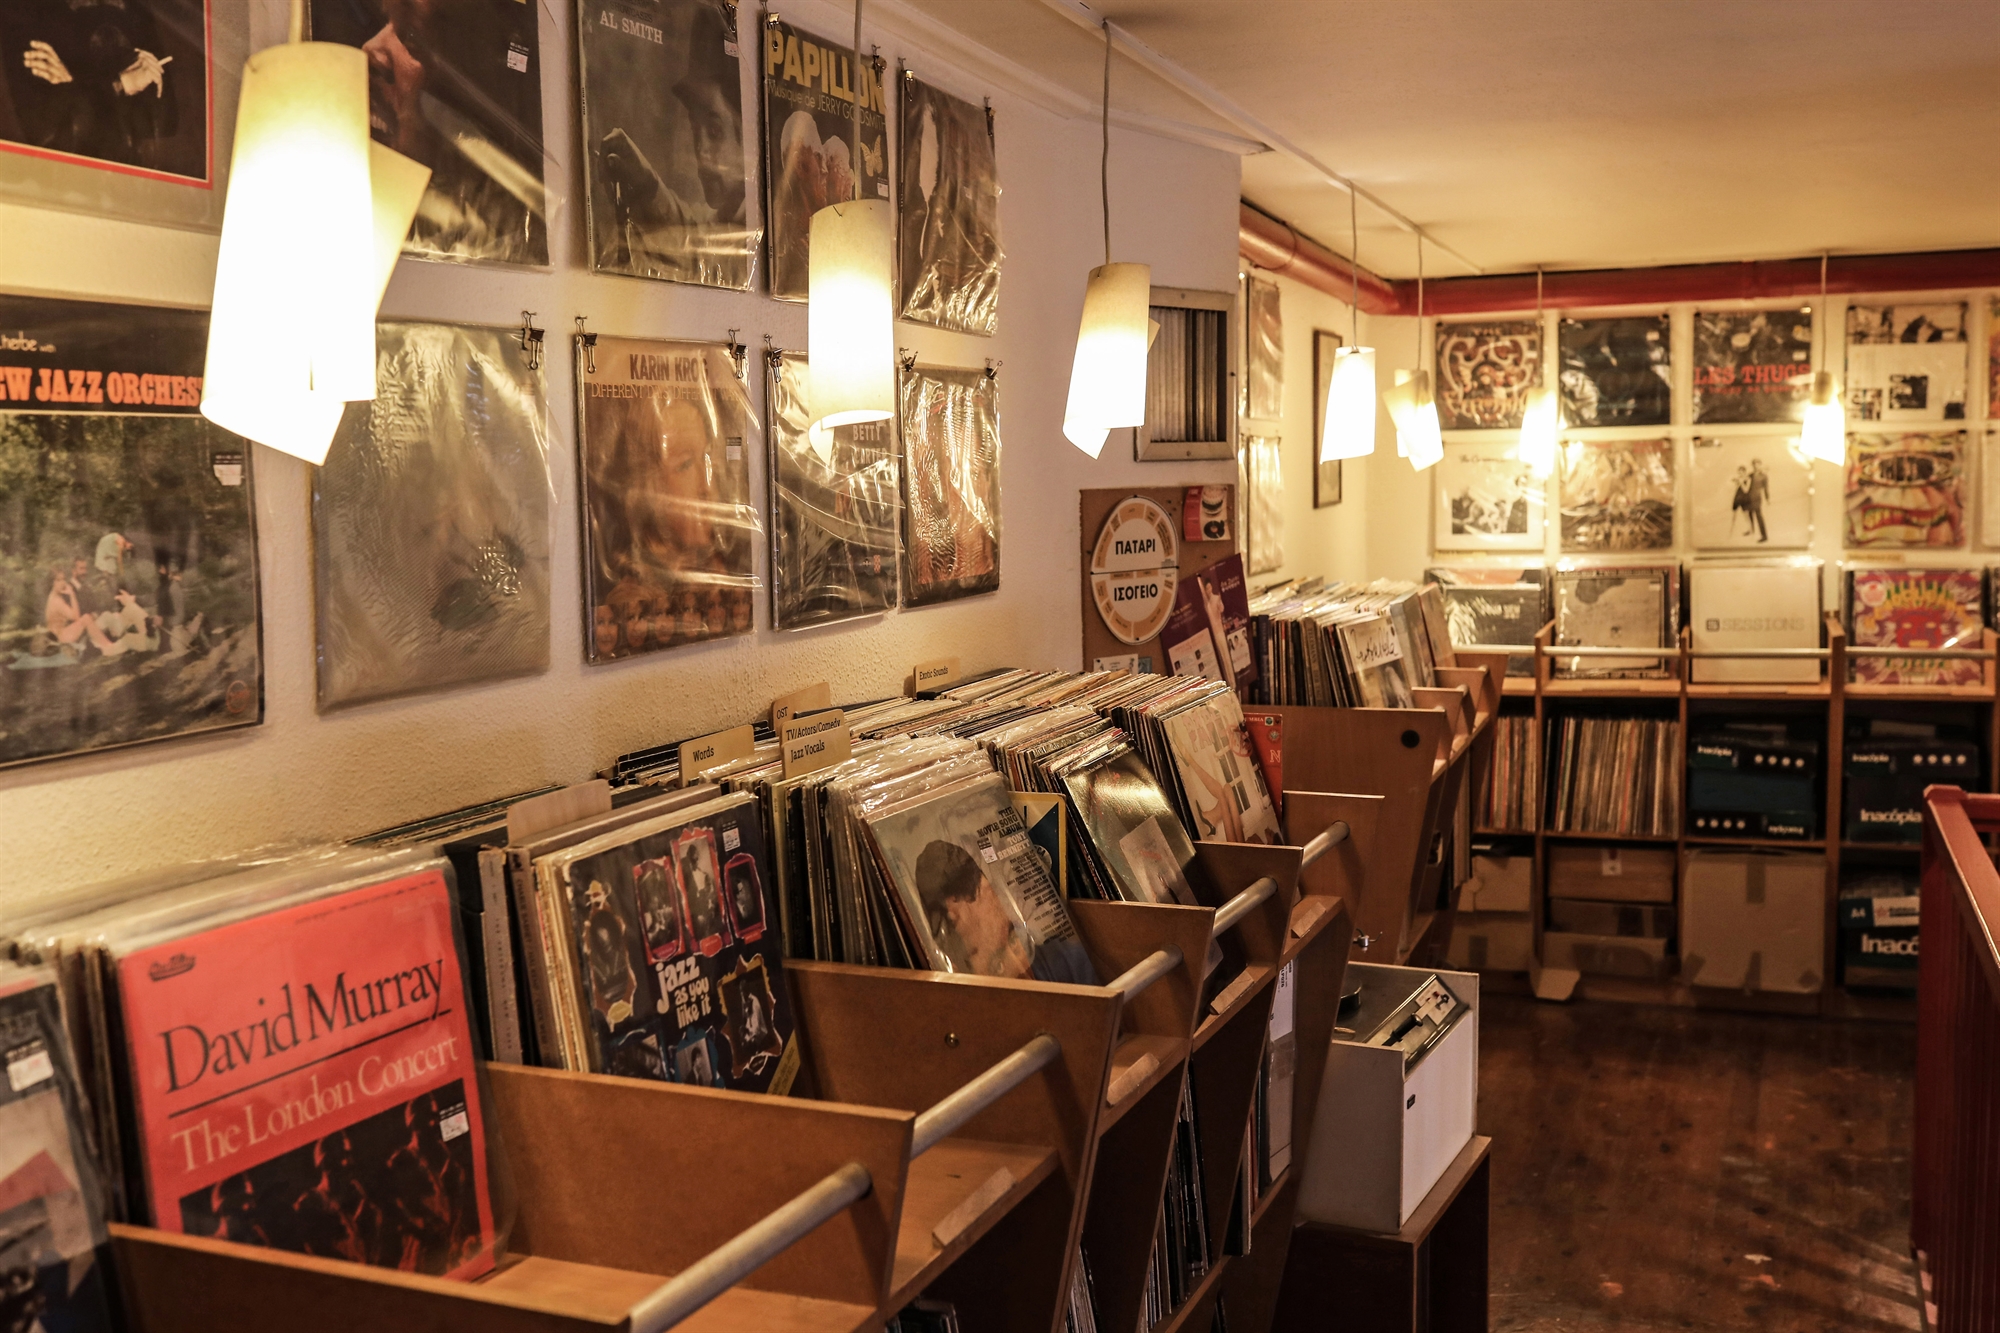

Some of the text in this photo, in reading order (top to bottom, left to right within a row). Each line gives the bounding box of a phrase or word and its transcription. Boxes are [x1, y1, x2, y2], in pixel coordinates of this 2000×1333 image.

[600, 10, 663, 44] AL SMITH
[767, 29, 886, 115] PAPILLON
[805, 89, 816, 108] de
[818, 94, 841, 115] JERRY
[842, 103, 886, 131] GODSMITH
[629, 353, 670, 381] KARIN
[1694, 365, 1735, 385] LES
[35, 368, 104, 403] JAZZ
[106, 371, 203, 406] ORCHES
[591, 382, 645, 399] DIFFERENT
[852, 424, 881, 441] BETTY
[1115, 538, 1156, 555] ΠΑΤΑΡΙ
[1114, 583, 1159, 601] ΙΣΟΓΕΙΟ
[933, 665, 949, 678] Sounds
[776, 706, 789, 720] OST
[692, 746, 715, 762] Words
[790, 739, 826, 763] Jazz Vocals
[998, 806, 1014, 818] THE
[976, 814, 1019, 838] MOVIE SONG
[998, 823, 1023, 839] ALBUM
[996, 838, 1031, 861] BENNETT
[1006, 831, 1027, 846] TONY
[655, 955, 700, 1014] jazz
[674, 977, 710, 1005] as you
[676, 993, 712, 1029] like it
[159, 959, 443, 1094] David Murray
[170, 1037, 459, 1172] The London Concert
